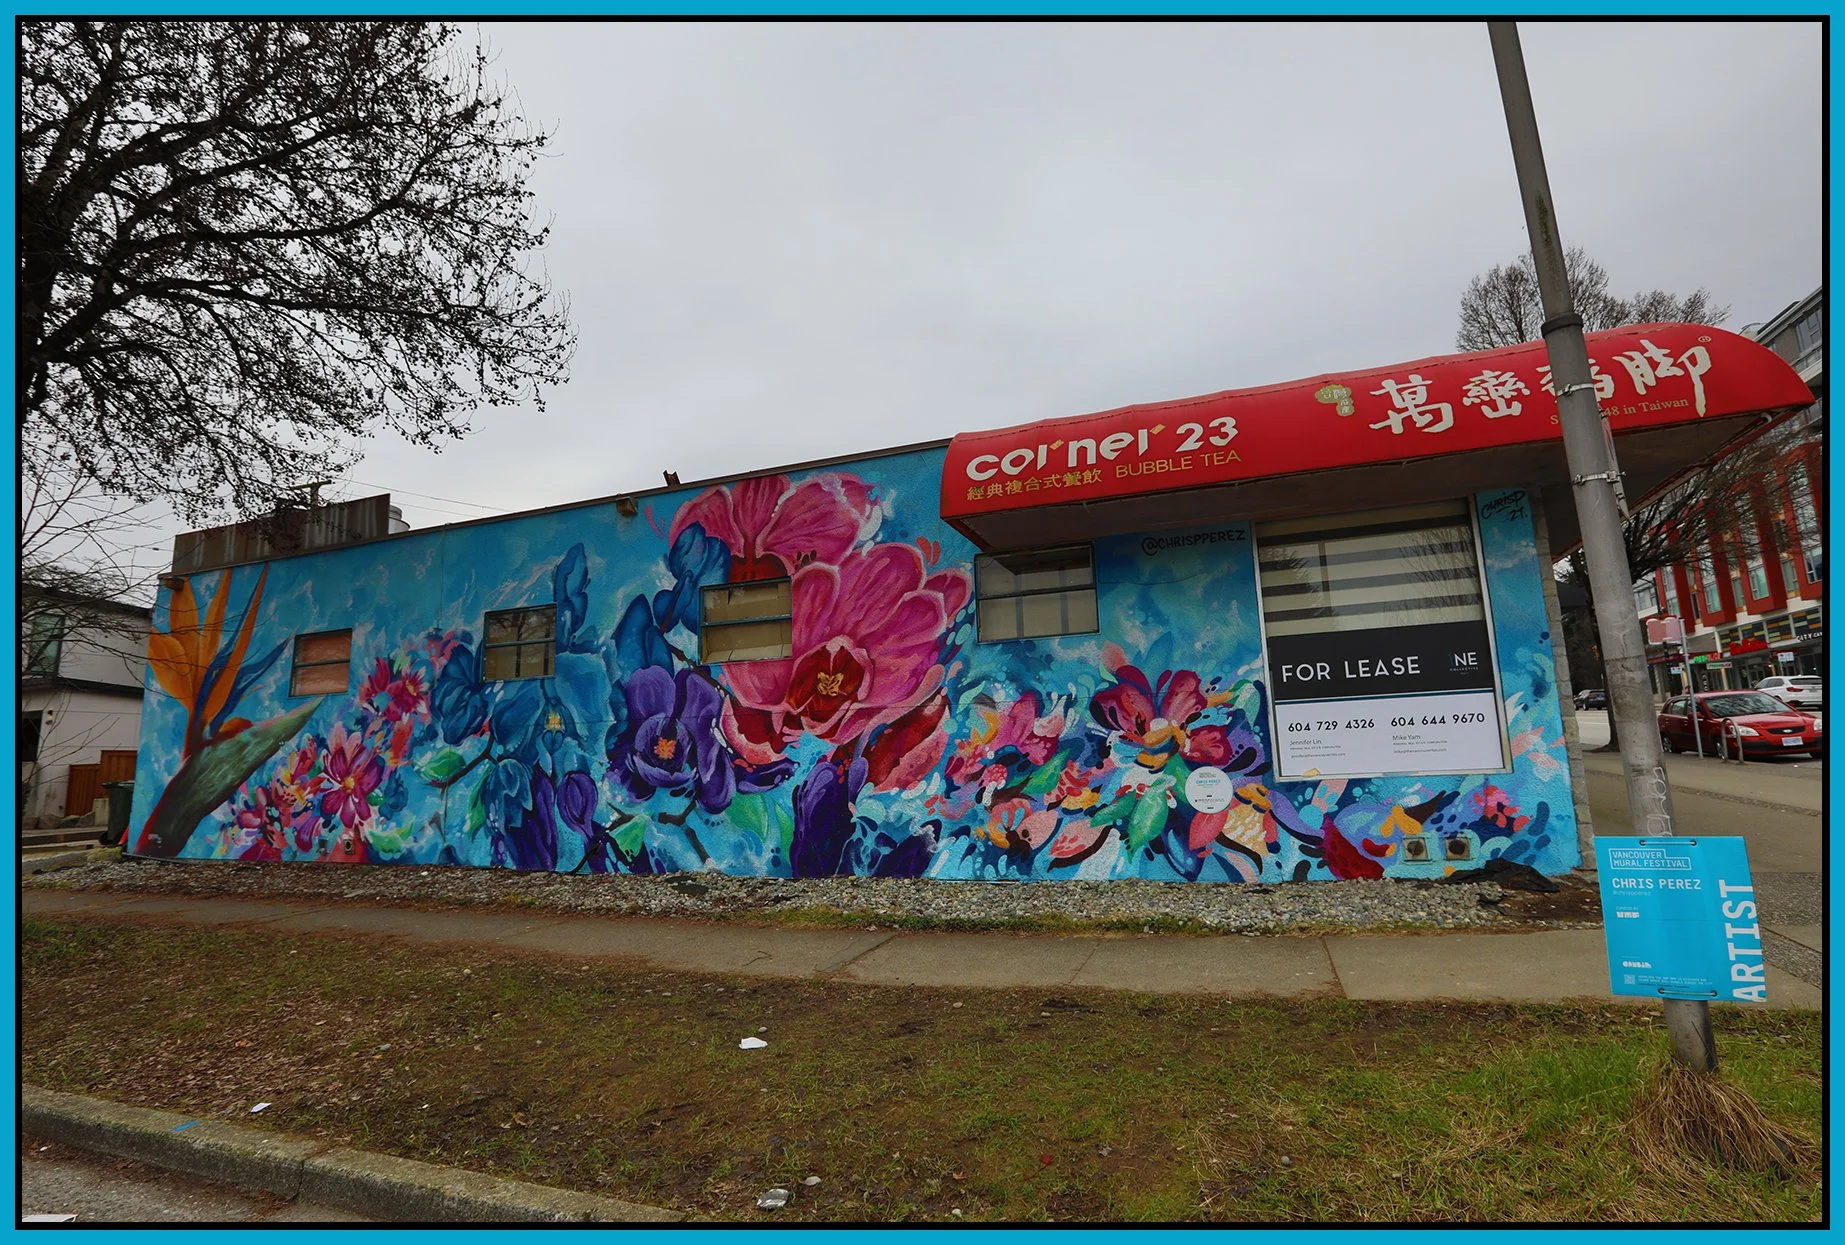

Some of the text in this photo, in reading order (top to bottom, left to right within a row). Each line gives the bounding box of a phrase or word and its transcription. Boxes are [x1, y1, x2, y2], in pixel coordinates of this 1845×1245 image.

[1624, 404, 1636, 415] in
[1638, 398, 1689, 413] Taiwan
[966, 416, 1239, 481] corner 23
[1115, 449, 1242, 478] BUBBLE TEA
[966, 468, 1103, 501] 經典複合式餐飲
[1141, 529, 1246, 556] @CHRISPPEREZ
[1281, 656, 1421, 683] FOR LEASE
[1288, 719, 1375, 732] 604 729 4326
[1391, 713, 1485, 727] 604 644 9670
[1612, 851, 1662, 859] VANCOUVER
[1613, 859, 1688, 868] MURAL FESTIVAL
[1612, 878, 1702, 890] CHRIS PEREZ
[1718, 879, 1767, 1003] ARTIST
